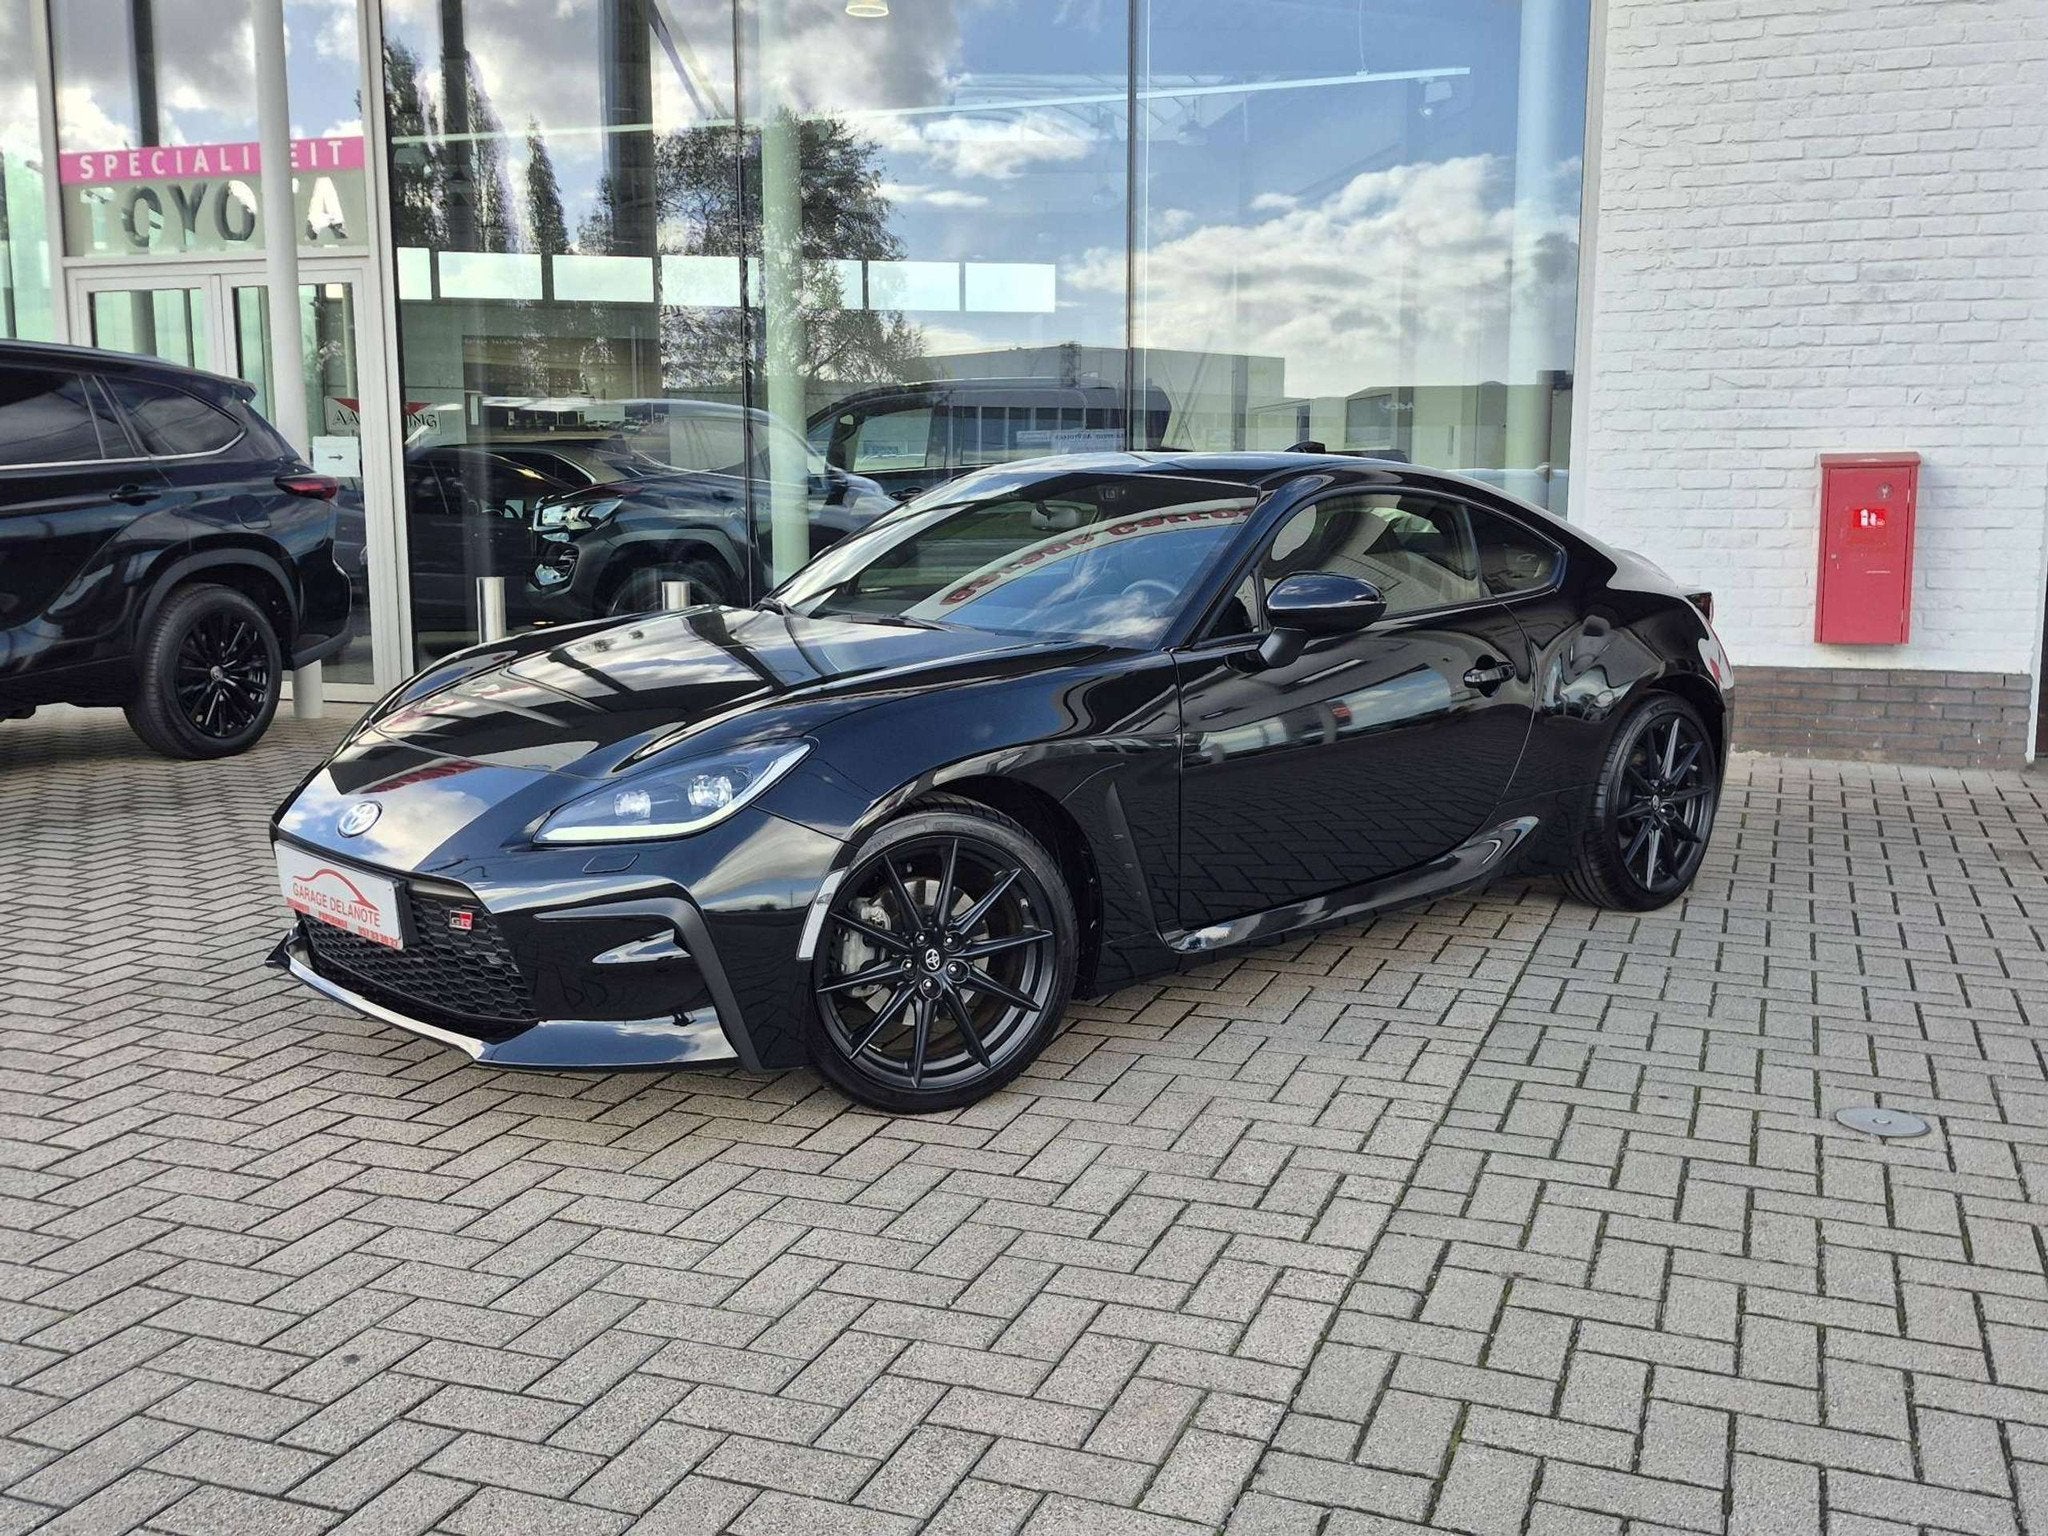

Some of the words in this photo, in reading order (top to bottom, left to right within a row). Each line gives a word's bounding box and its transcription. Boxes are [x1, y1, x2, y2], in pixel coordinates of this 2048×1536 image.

[80, 141, 343, 179] SPECIALIEIT
[80, 176, 348, 249] TOYOA
[293, 883, 328, 907] GARAGE
[330, 897, 381, 927] DELANOTE
